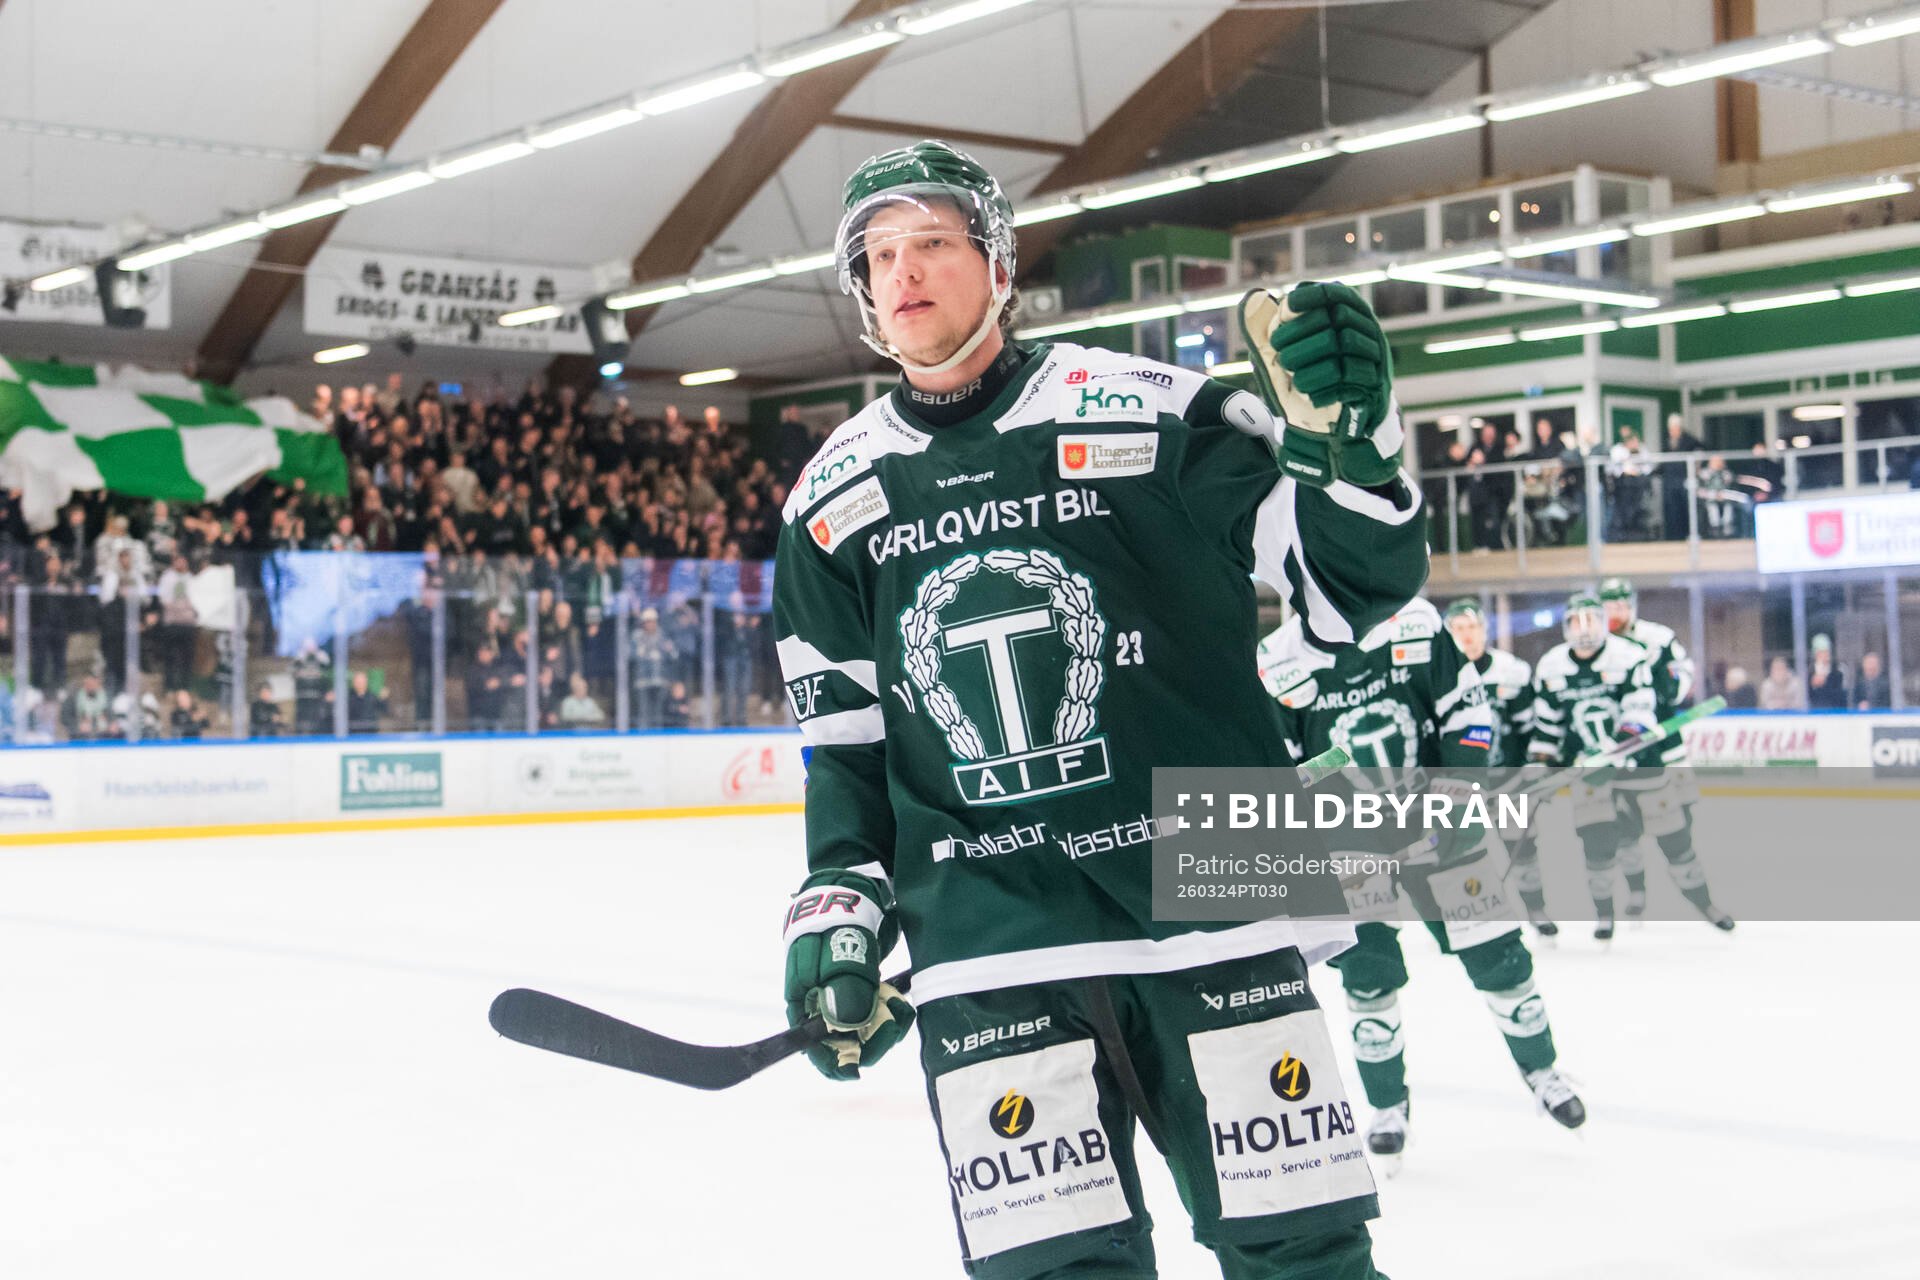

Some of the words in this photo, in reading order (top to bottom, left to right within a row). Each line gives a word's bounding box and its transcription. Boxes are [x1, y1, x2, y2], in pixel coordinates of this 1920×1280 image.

[911, 377, 982, 404] BAUER
[1088, 443, 1153, 459] Tingsryds
[1092, 456, 1152, 469] kommun
[830, 500, 884, 534] kommun
[868, 494, 1046, 566] CARLQVIST
[1055, 488, 1111, 523] BIL
[1115, 630, 1144, 666] 23
[948, 821, 1047, 858] hallabr
[1229, 980, 1305, 1007] BAUER
[963, 1015, 1051, 1052] BAUER
[1213, 1100, 1356, 1156] HOLTAB
[1220, 1168, 1272, 1182] Kunskap
[1281, 1157, 1322, 1174] Service
[1004, 1193, 1046, 1210] Service
